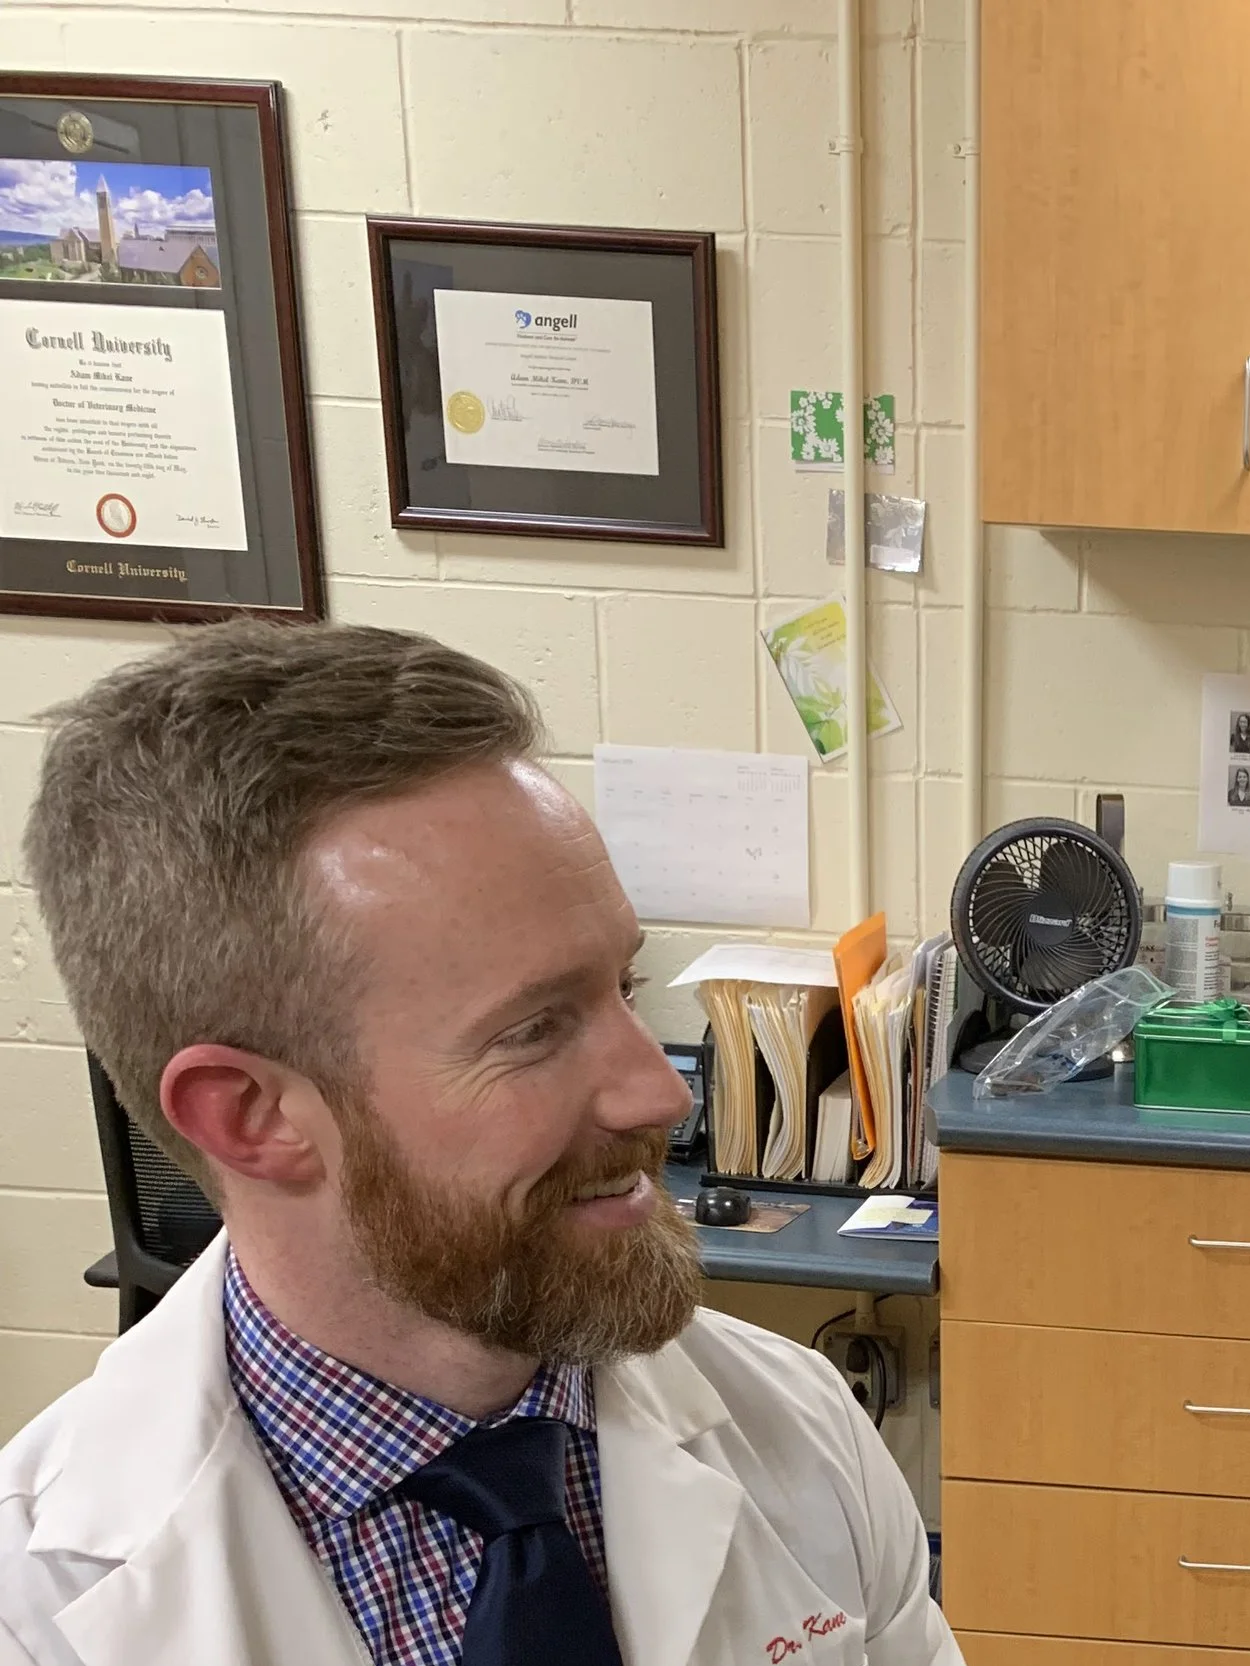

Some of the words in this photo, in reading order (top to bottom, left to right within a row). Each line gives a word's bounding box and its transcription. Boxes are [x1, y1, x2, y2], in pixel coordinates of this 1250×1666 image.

[534, 314, 578, 331] angell
[25, 326, 85, 350] Cornell
[91, 330, 173, 362] University
[66, 559, 114, 575] Cornell
[118, 562, 188, 583] University
